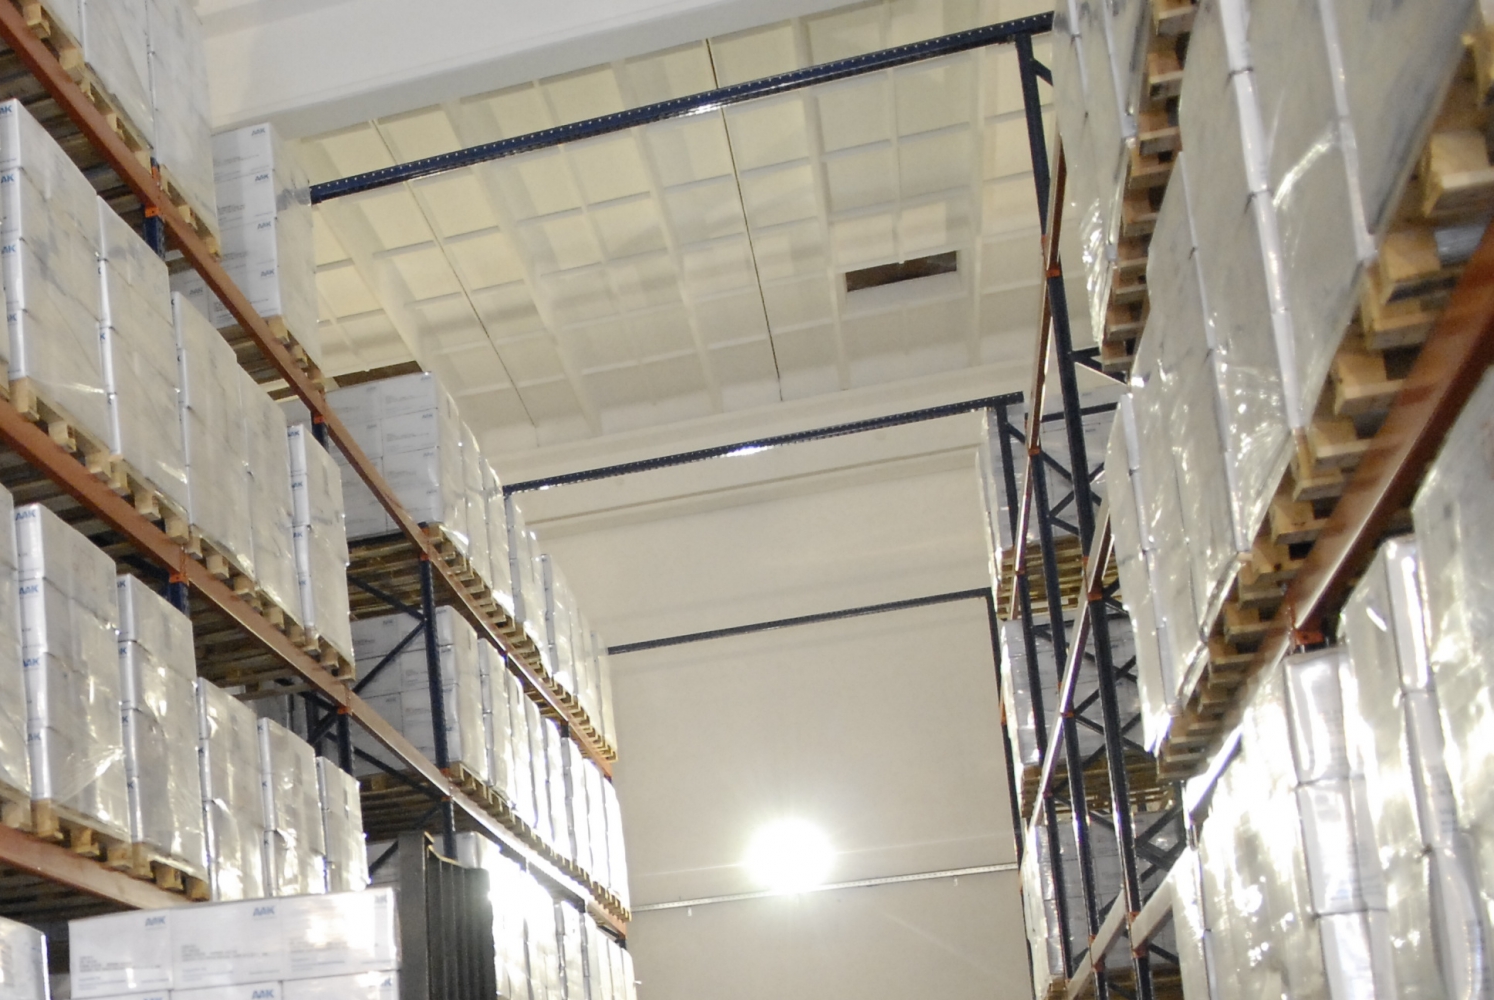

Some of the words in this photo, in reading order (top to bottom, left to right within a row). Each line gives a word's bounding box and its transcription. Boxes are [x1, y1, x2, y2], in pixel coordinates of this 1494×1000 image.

[15, 510, 37, 521] AAK
[253, 905, 276, 917] AAK
[144, 916, 166, 927] AAK
[251, 989, 275, 1000] AAK
